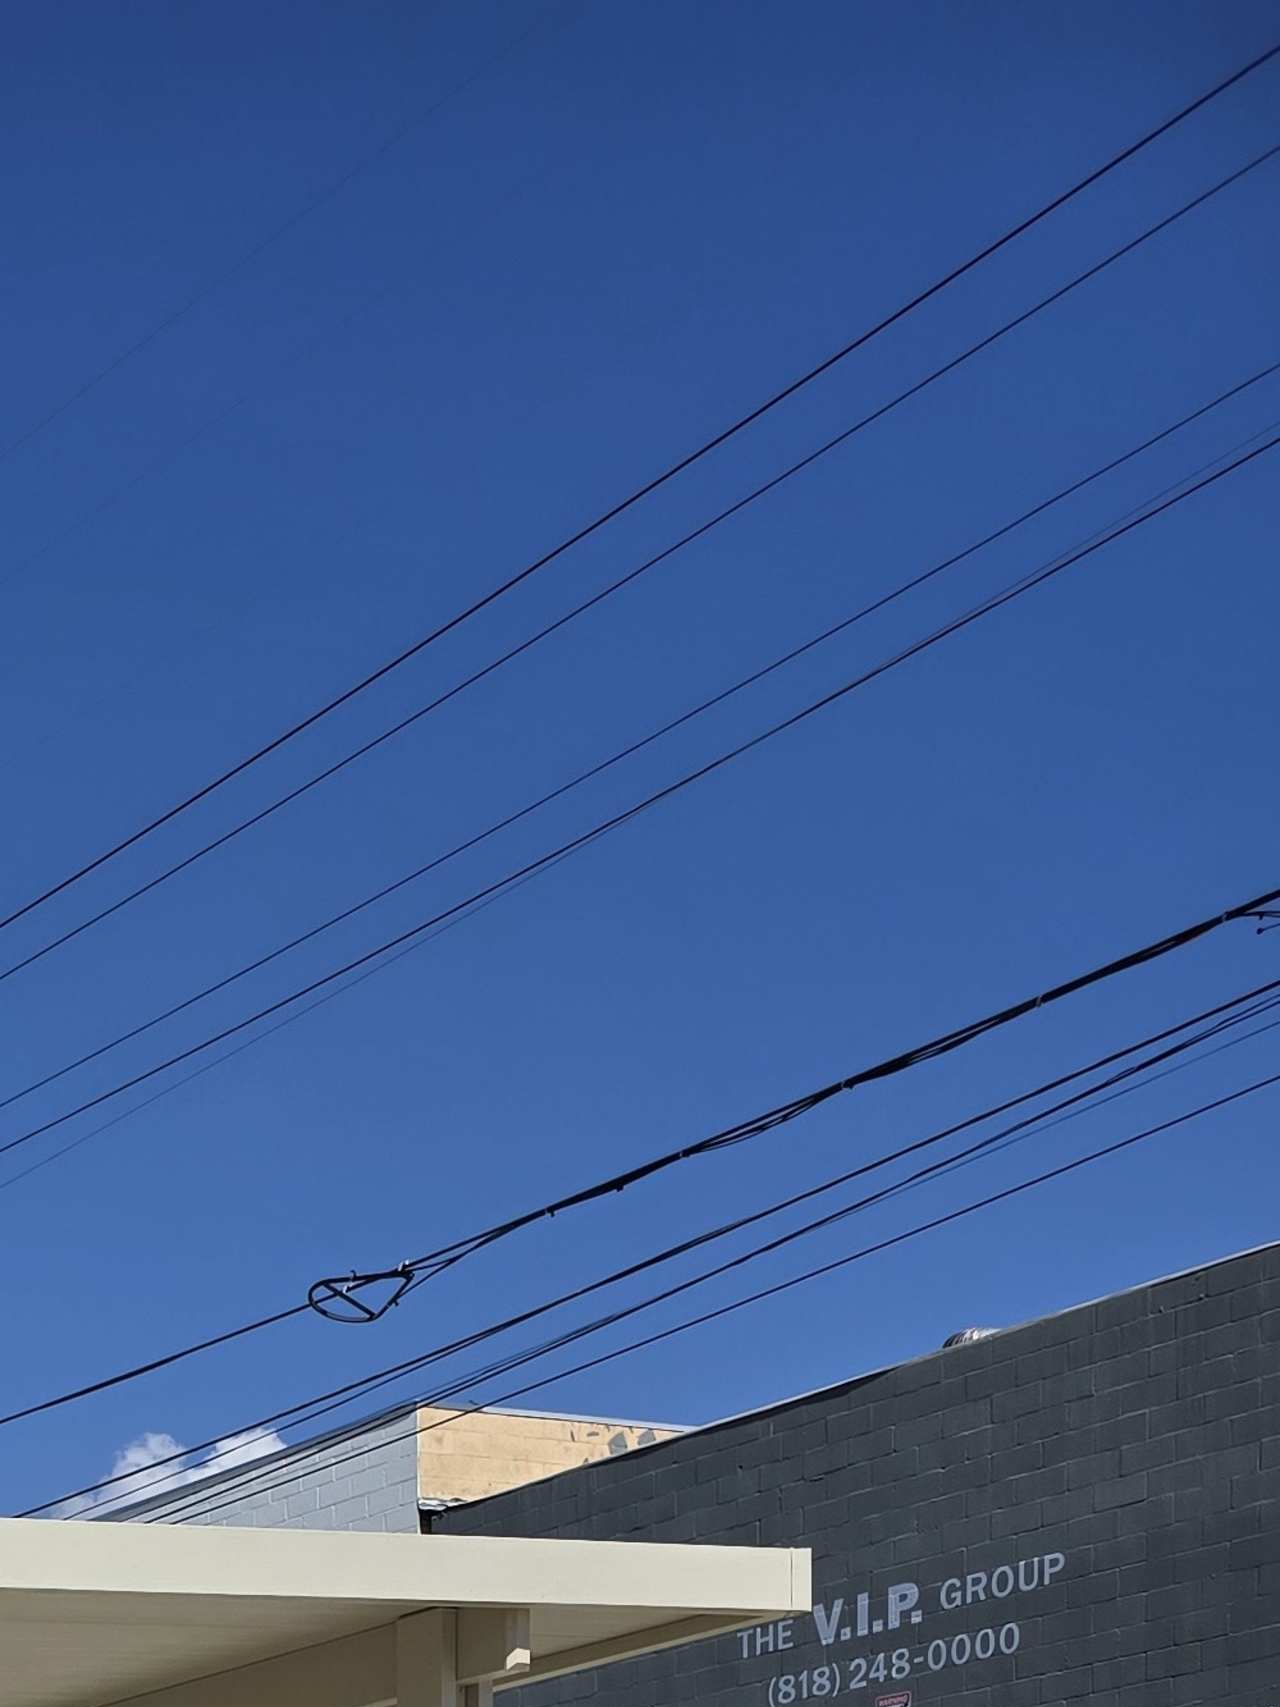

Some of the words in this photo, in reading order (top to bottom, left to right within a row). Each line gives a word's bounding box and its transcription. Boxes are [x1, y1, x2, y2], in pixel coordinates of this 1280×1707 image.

[737, 1619, 794, 1659] THE
[813, 1582, 923, 1646] V.I.P.
[940, 1552, 1066, 1610] GROUP
[849, 1622, 1020, 1689] 248-0000
